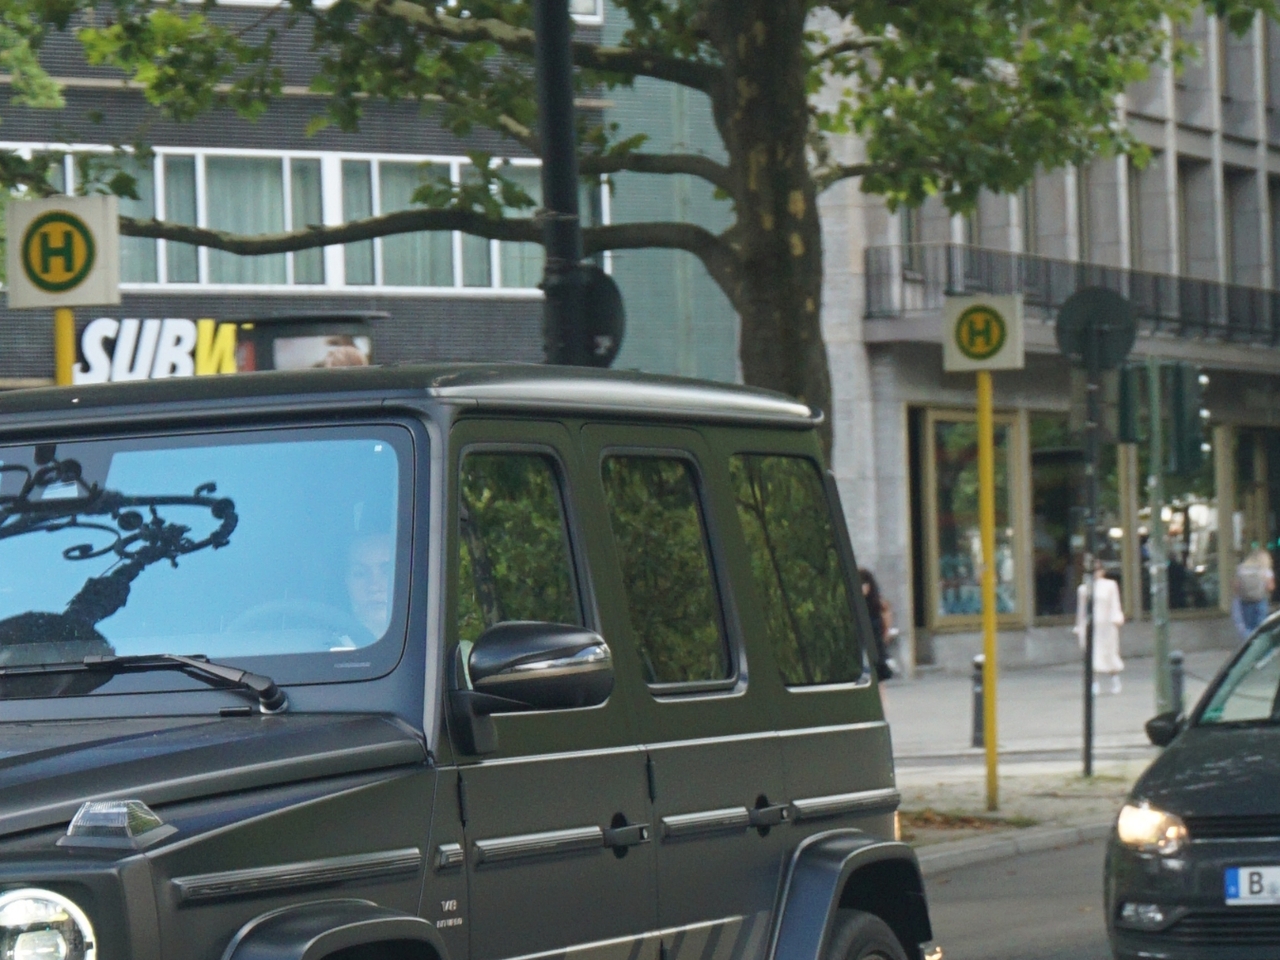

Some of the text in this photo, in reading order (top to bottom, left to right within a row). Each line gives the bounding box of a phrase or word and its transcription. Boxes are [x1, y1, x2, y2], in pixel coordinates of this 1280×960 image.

[39, 230, 75, 274] H
[969, 319, 992, 345] H
[73, 317, 255, 385] SUBW
[1248, 871, 1264, 895] B
